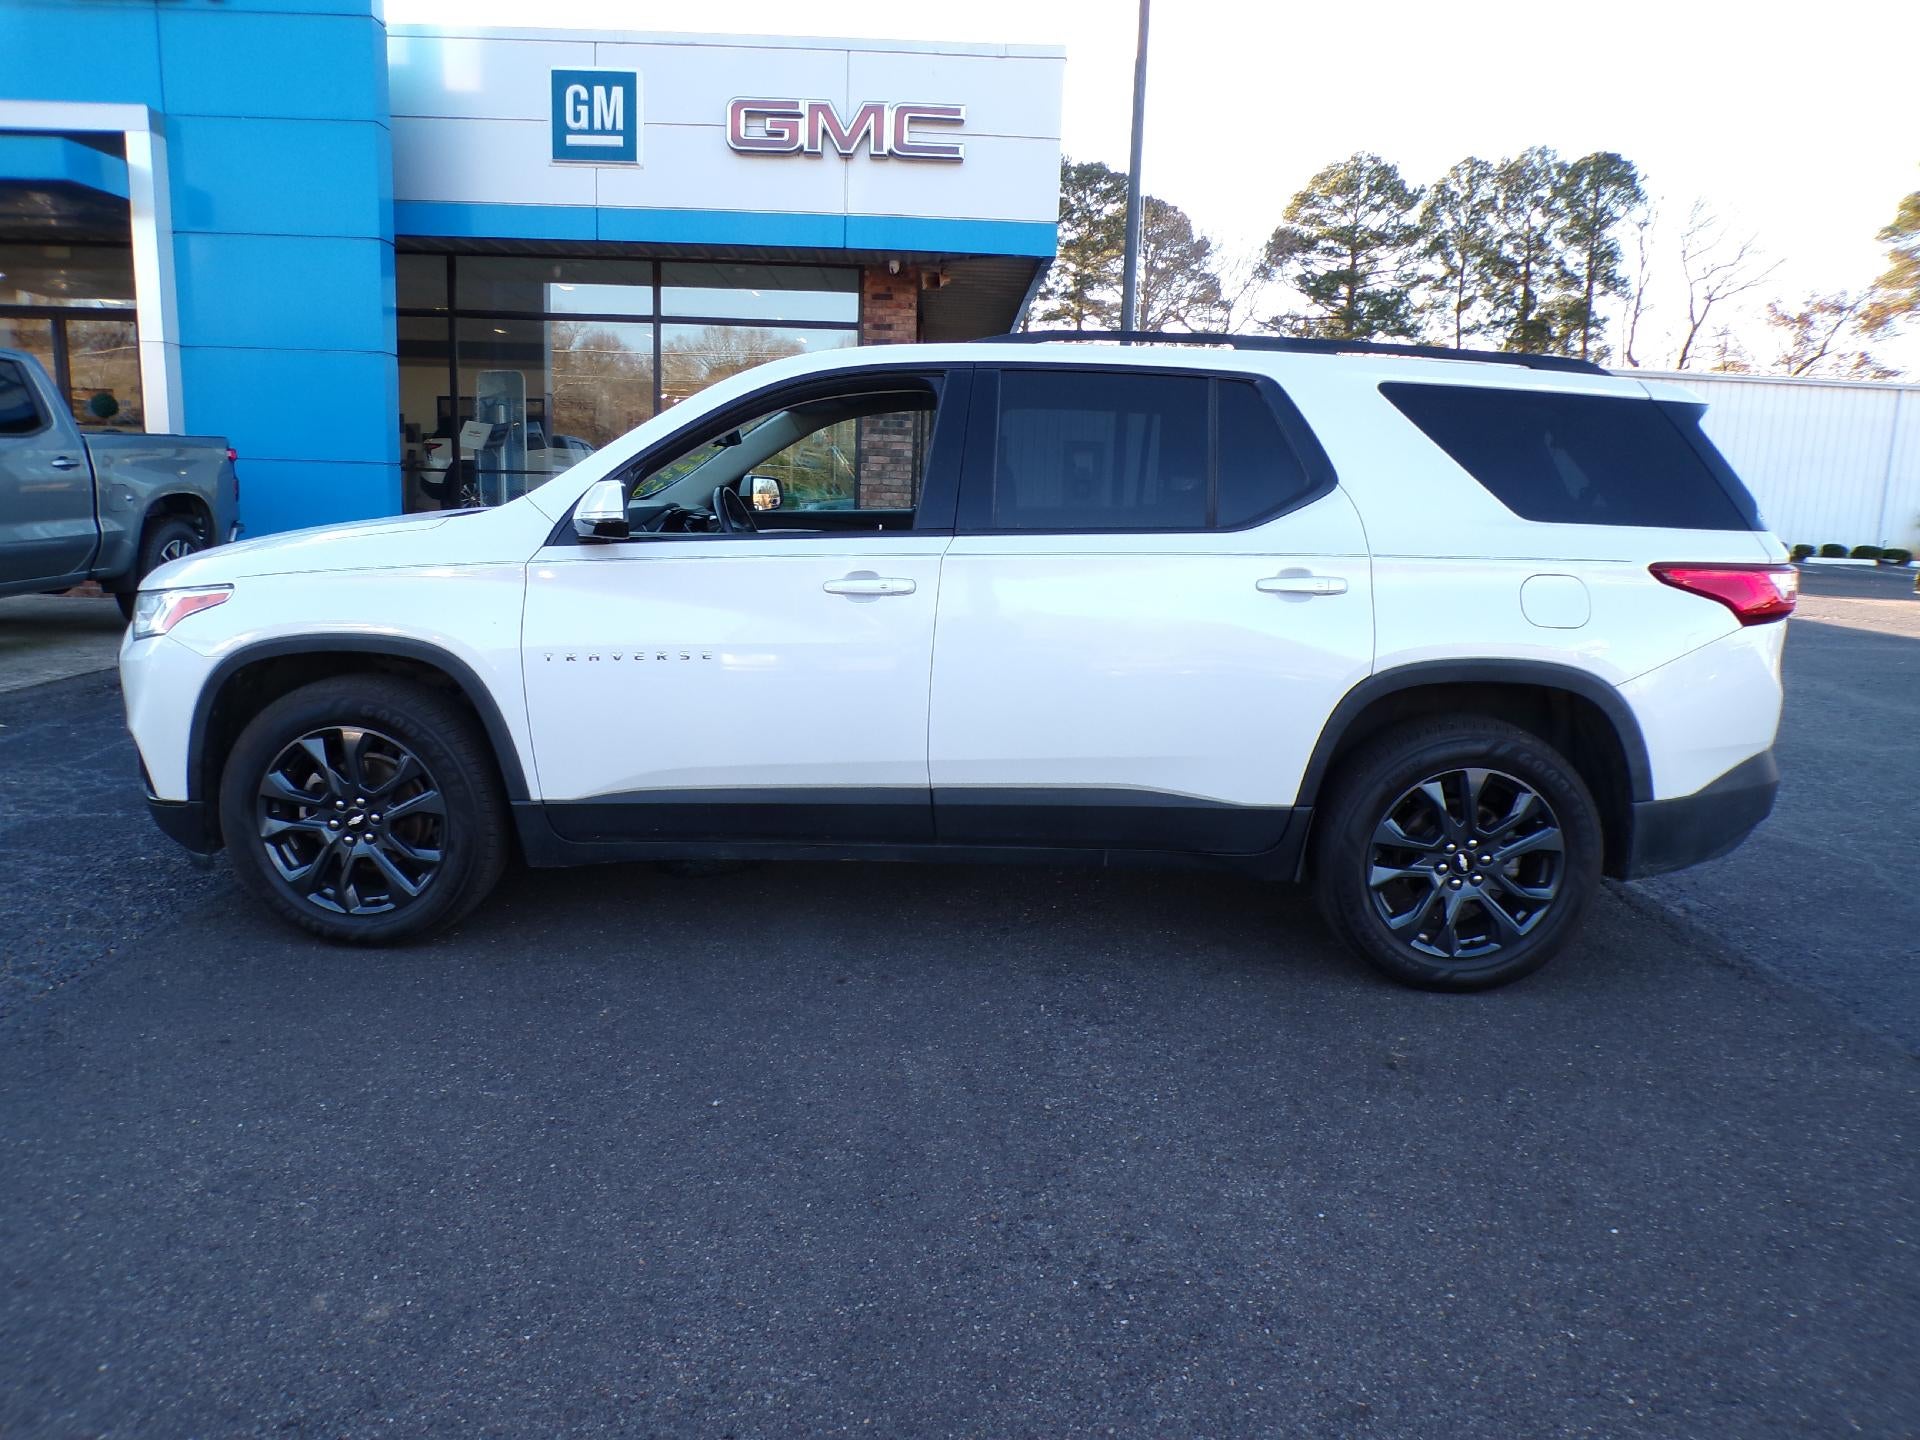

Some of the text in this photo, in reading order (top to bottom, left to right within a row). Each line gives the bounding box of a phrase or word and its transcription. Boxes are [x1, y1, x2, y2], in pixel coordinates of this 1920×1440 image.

[566, 84, 624, 131] GM
[726, 96, 966, 163] GMC
[543, 651, 713, 662] TRAVERSE
